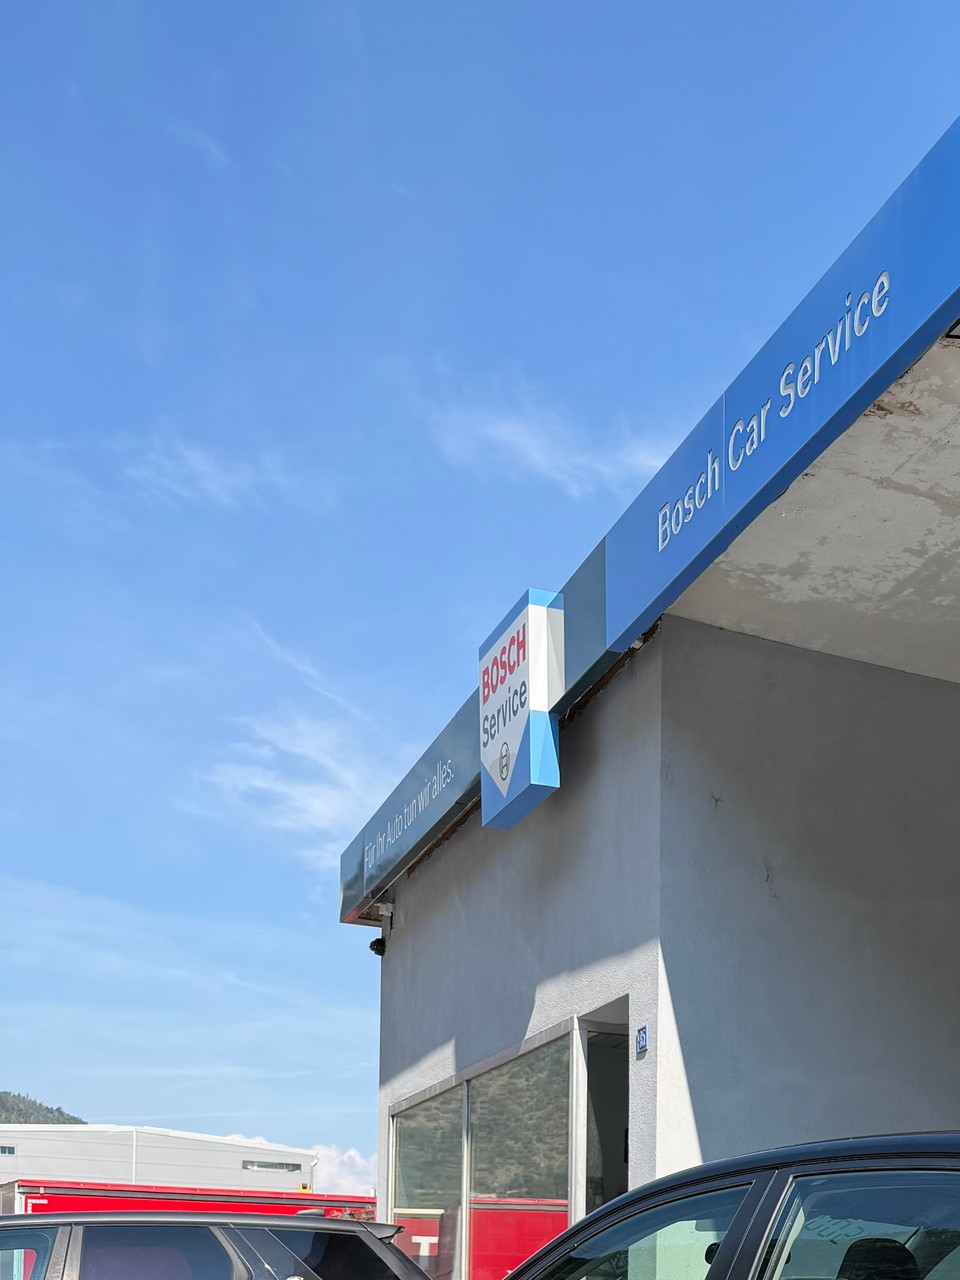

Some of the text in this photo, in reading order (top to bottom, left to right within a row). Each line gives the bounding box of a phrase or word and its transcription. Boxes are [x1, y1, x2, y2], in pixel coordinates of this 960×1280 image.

[658, 270, 890, 552] Bosch Car Service
[482, 623, 526, 705] BOSCH
[483, 680, 527, 748] Service
[364, 760, 454, 870] Für Ihr Auto tun wir alles.
